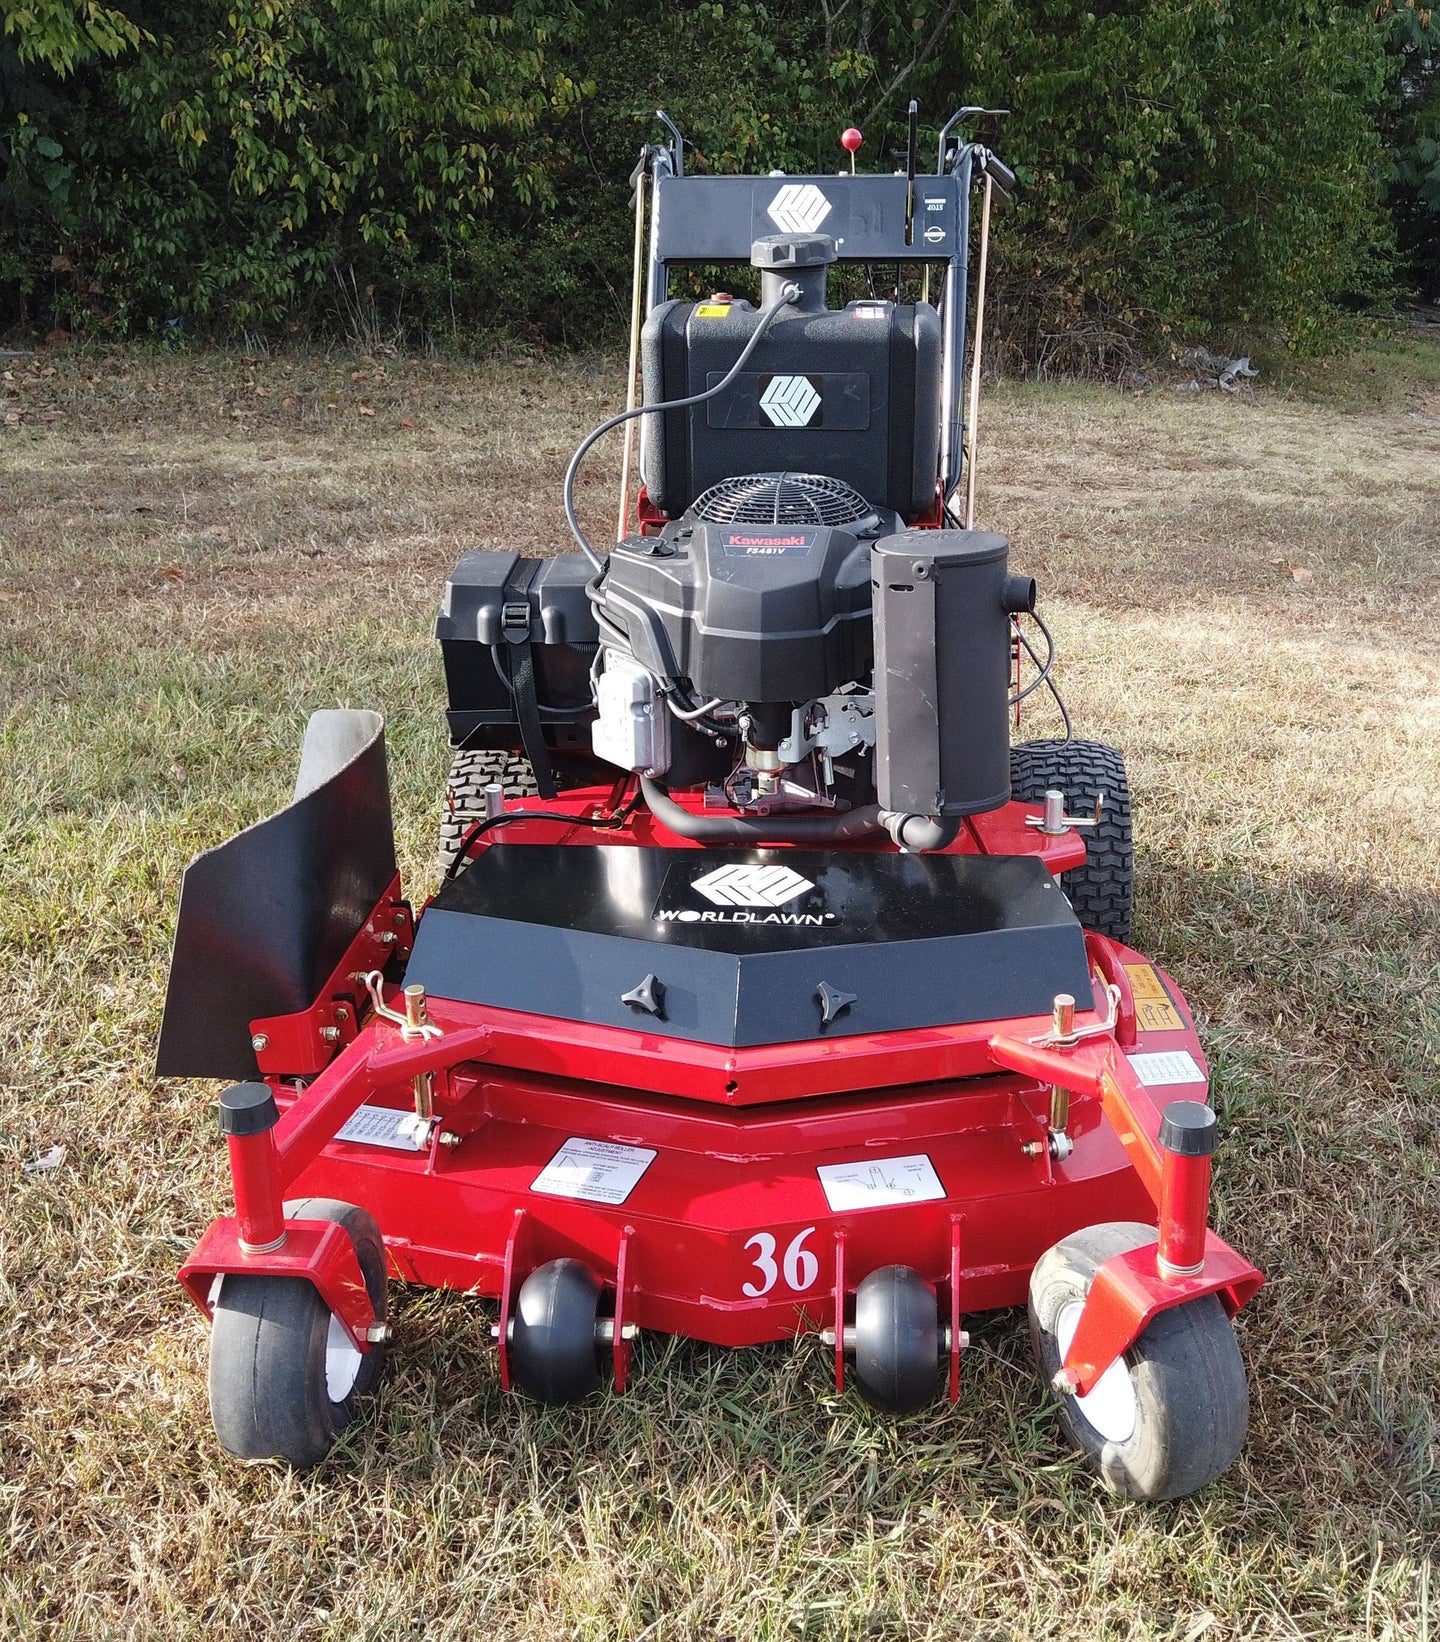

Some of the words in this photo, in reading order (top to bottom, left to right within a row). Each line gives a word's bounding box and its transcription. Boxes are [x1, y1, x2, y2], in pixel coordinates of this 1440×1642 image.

[729, 535, 805, 545] Kawasaki
[746, 547, 786, 555] FS481V
[589, 1147, 623, 1155] ADJUSTMENT
[742, 1226, 819, 1297] 36
